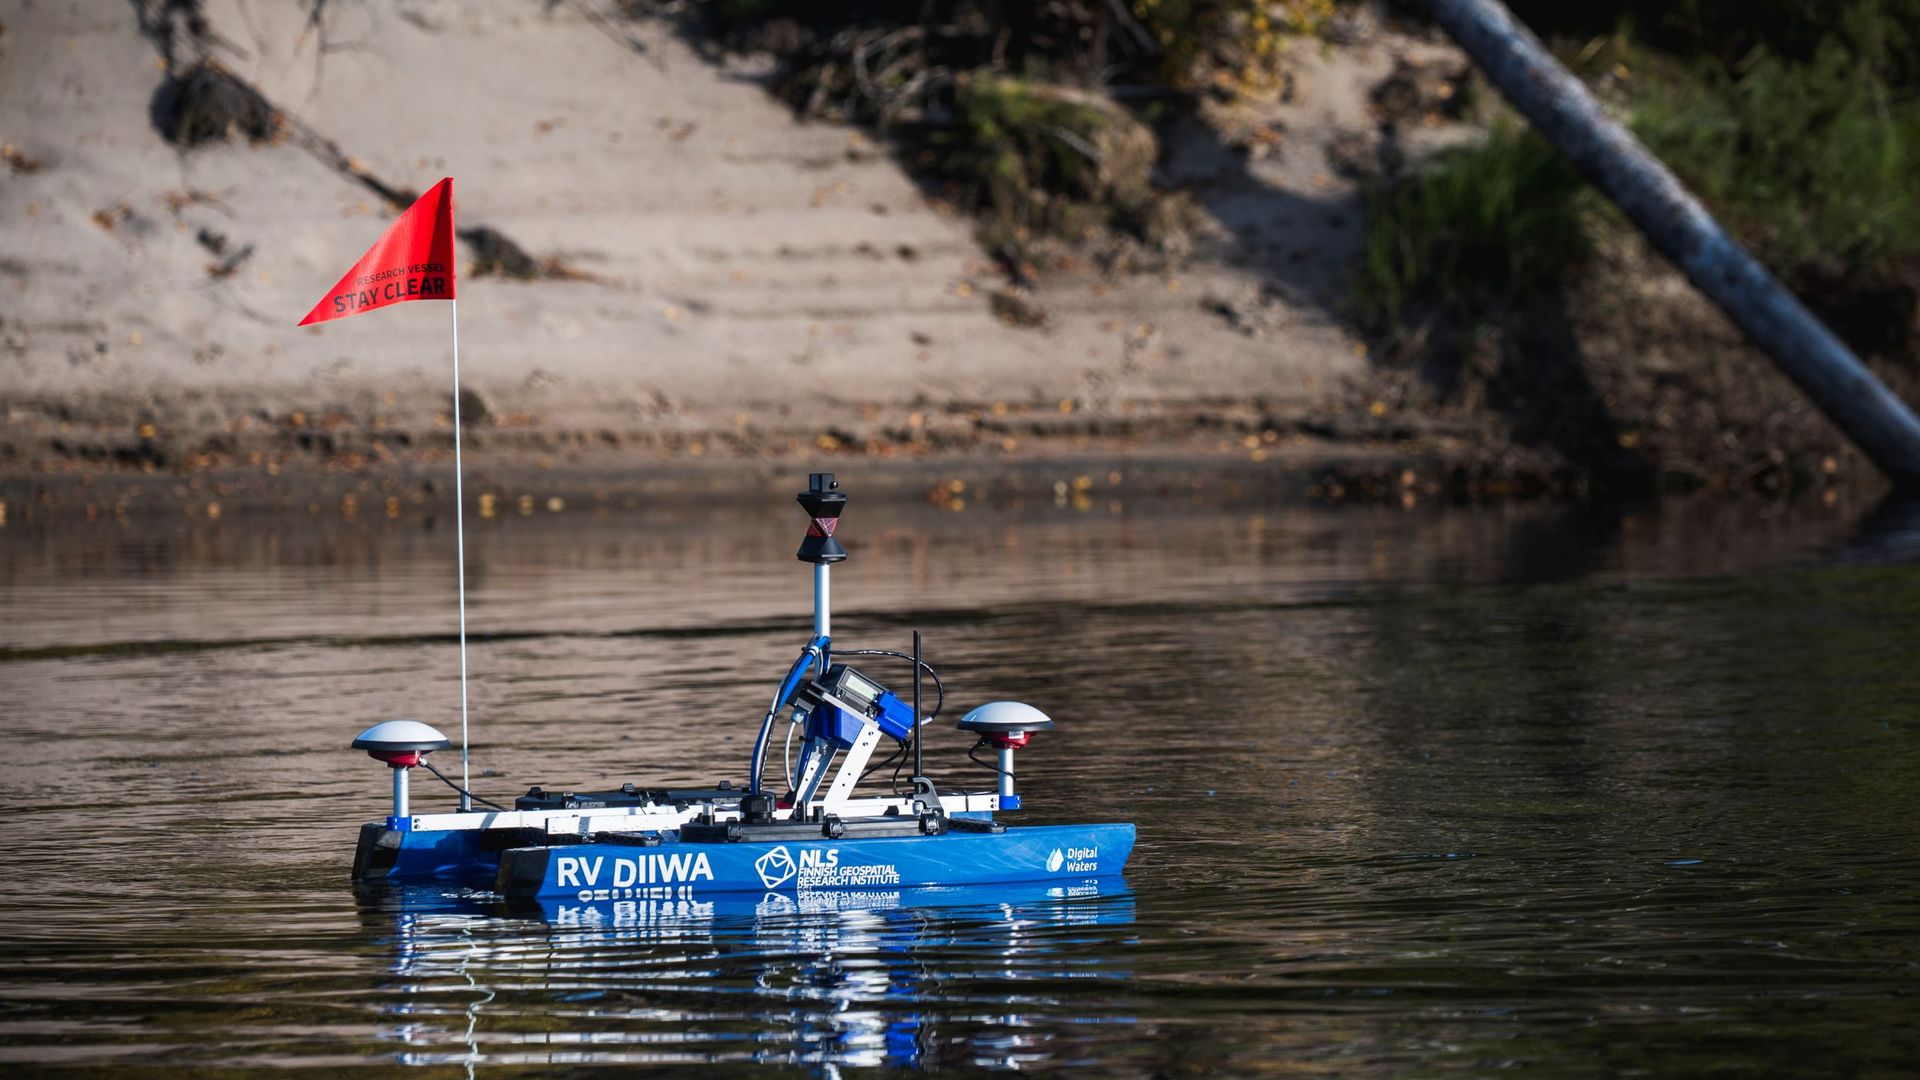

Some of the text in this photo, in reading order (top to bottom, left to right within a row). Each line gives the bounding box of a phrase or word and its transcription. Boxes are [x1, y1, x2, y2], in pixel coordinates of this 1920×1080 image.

[357, 263, 445, 286] RESEARCH VESSEL
[333, 277, 446, 313] STAY CLEAR
[799, 849, 838, 867] NLS
[1067, 846, 1097, 860] Digital
[557, 852, 715, 888] RV DIIWA
[798, 865, 897, 876] FINNISH GEOSPATIAL
[1066, 862, 1097, 872] Waters
[797, 875, 899, 886] RESEARCH INSTITUTE
